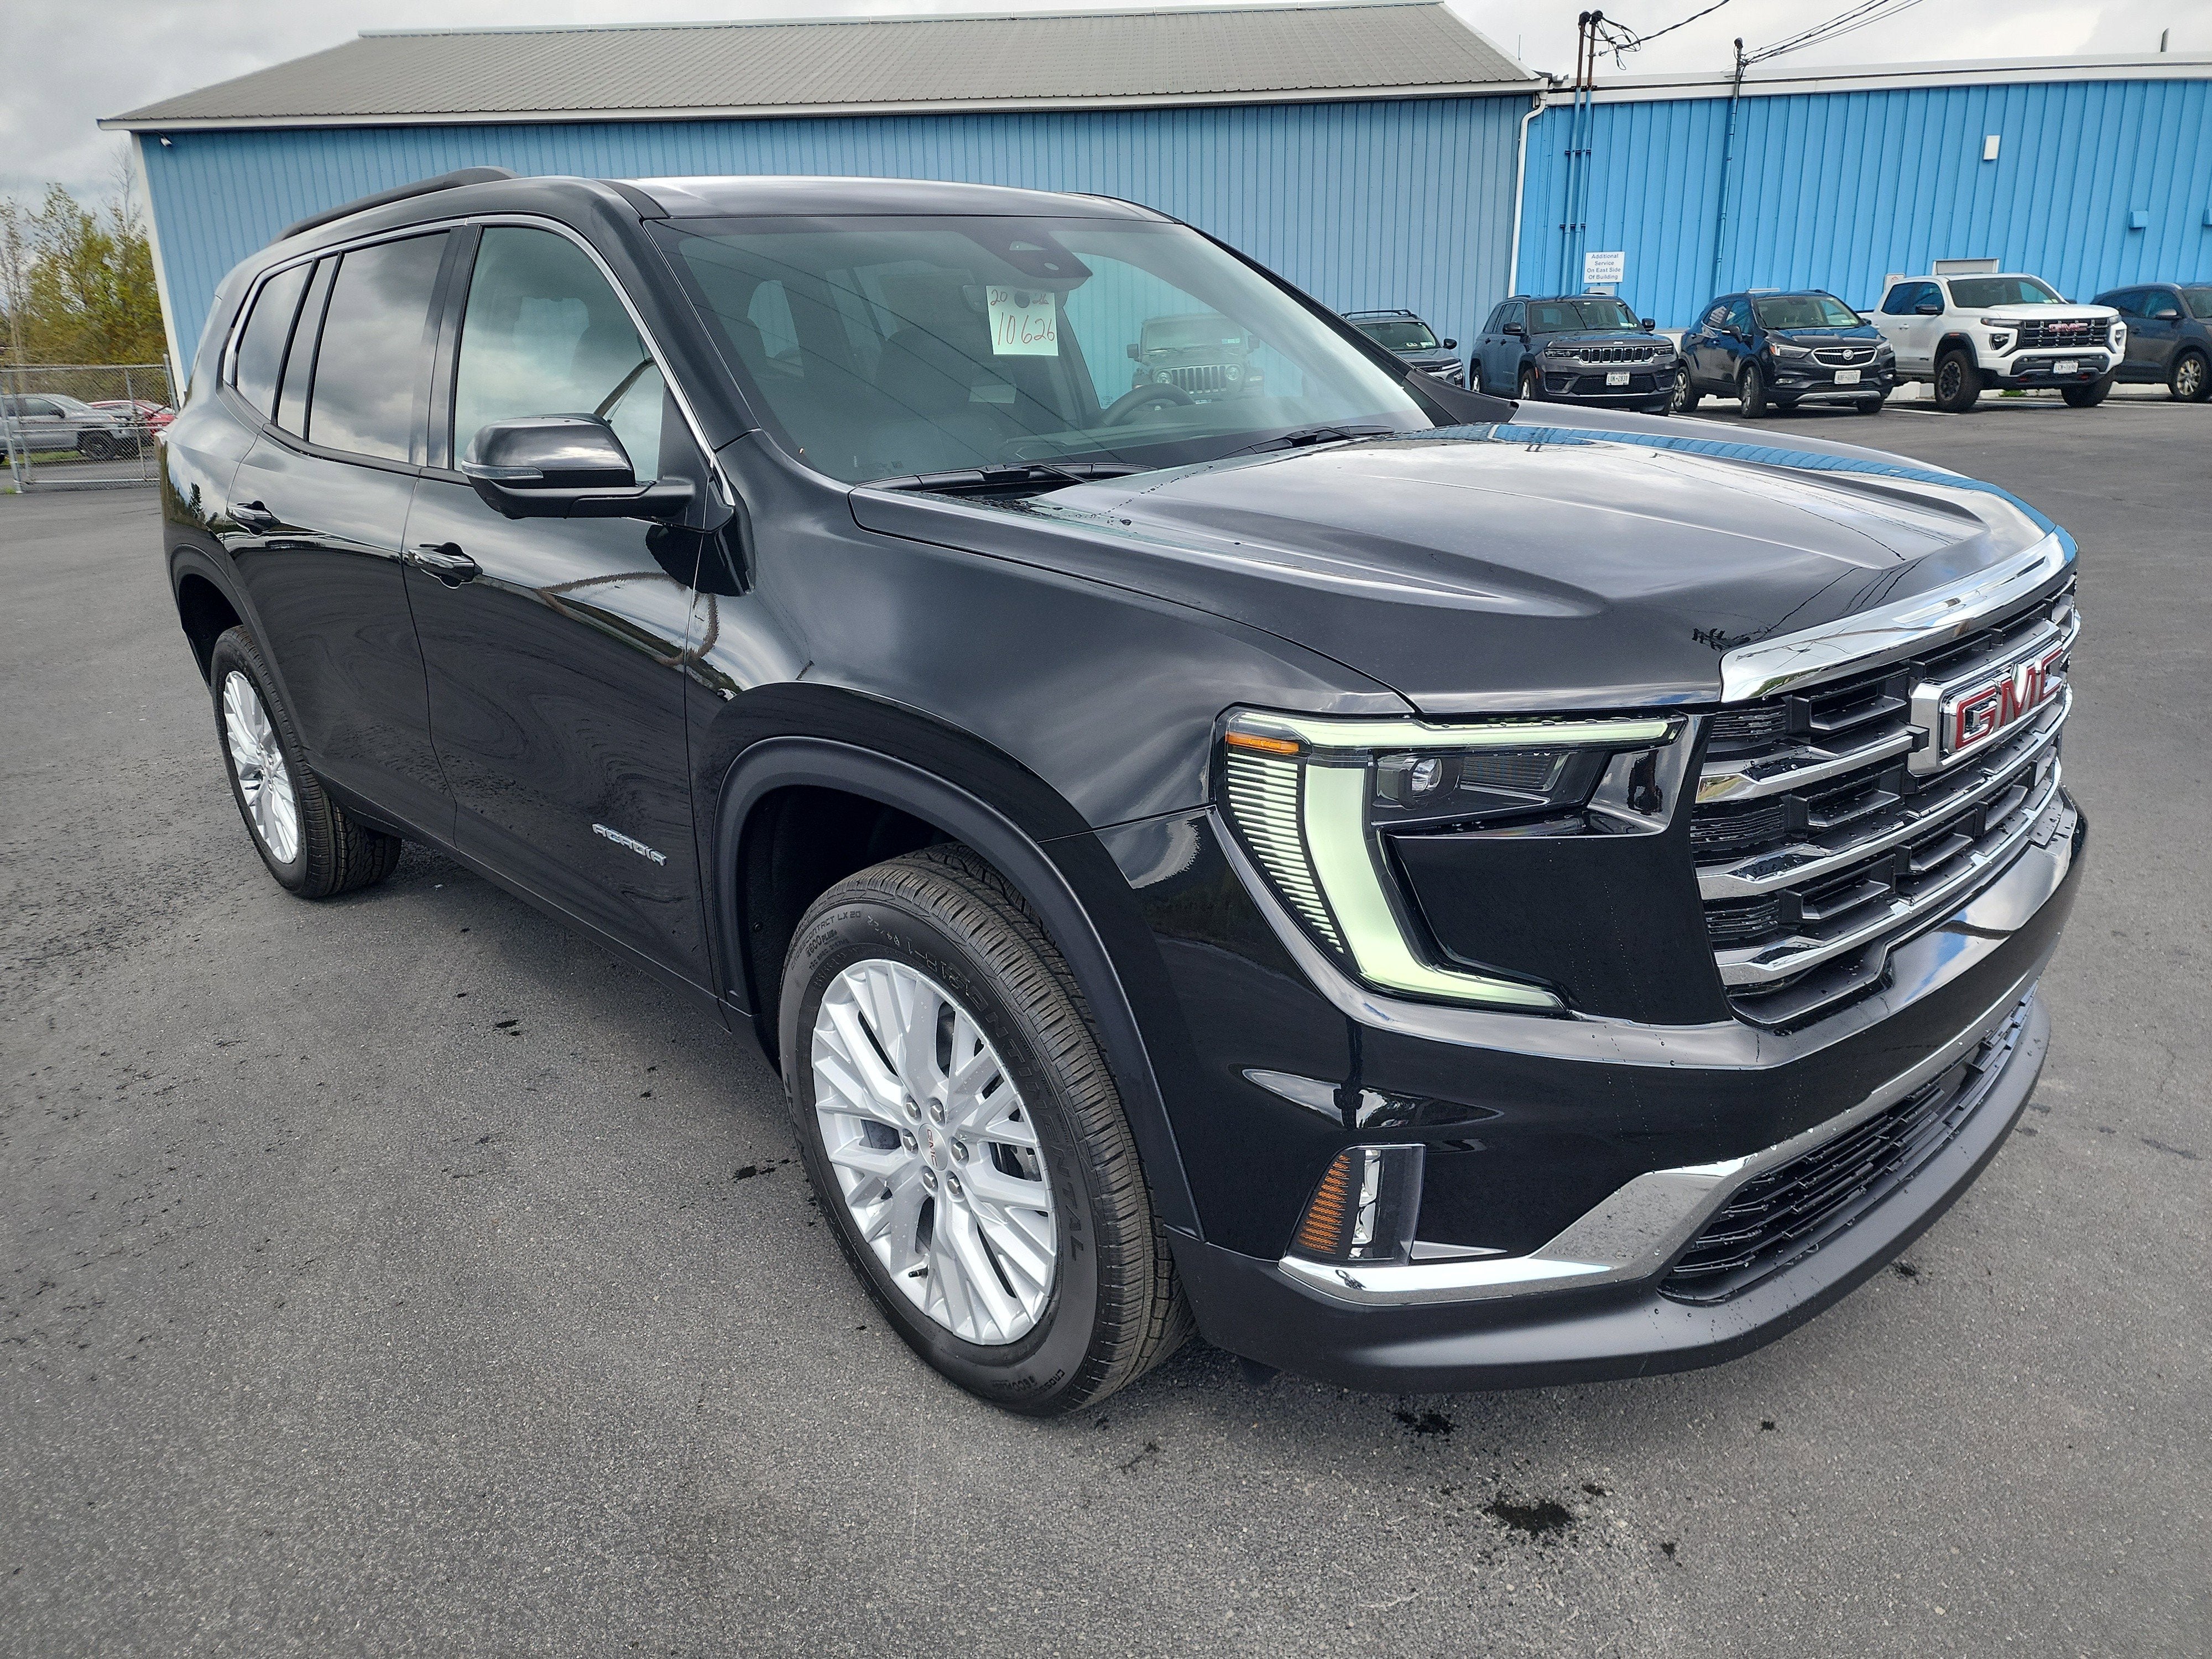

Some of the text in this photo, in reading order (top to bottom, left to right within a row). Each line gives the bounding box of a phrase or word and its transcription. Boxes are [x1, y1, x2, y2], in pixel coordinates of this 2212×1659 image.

[990, 289, 1008, 306] 20
[997, 311, 1056, 346] 10626
[2048, 322, 2088, 332] GMC
[1949, 641, 2064, 752] GMC
[592, 823, 667, 866] ACADIA
[837, 911, 848, 921] LX
[927, 1129, 938, 1167] GMC
